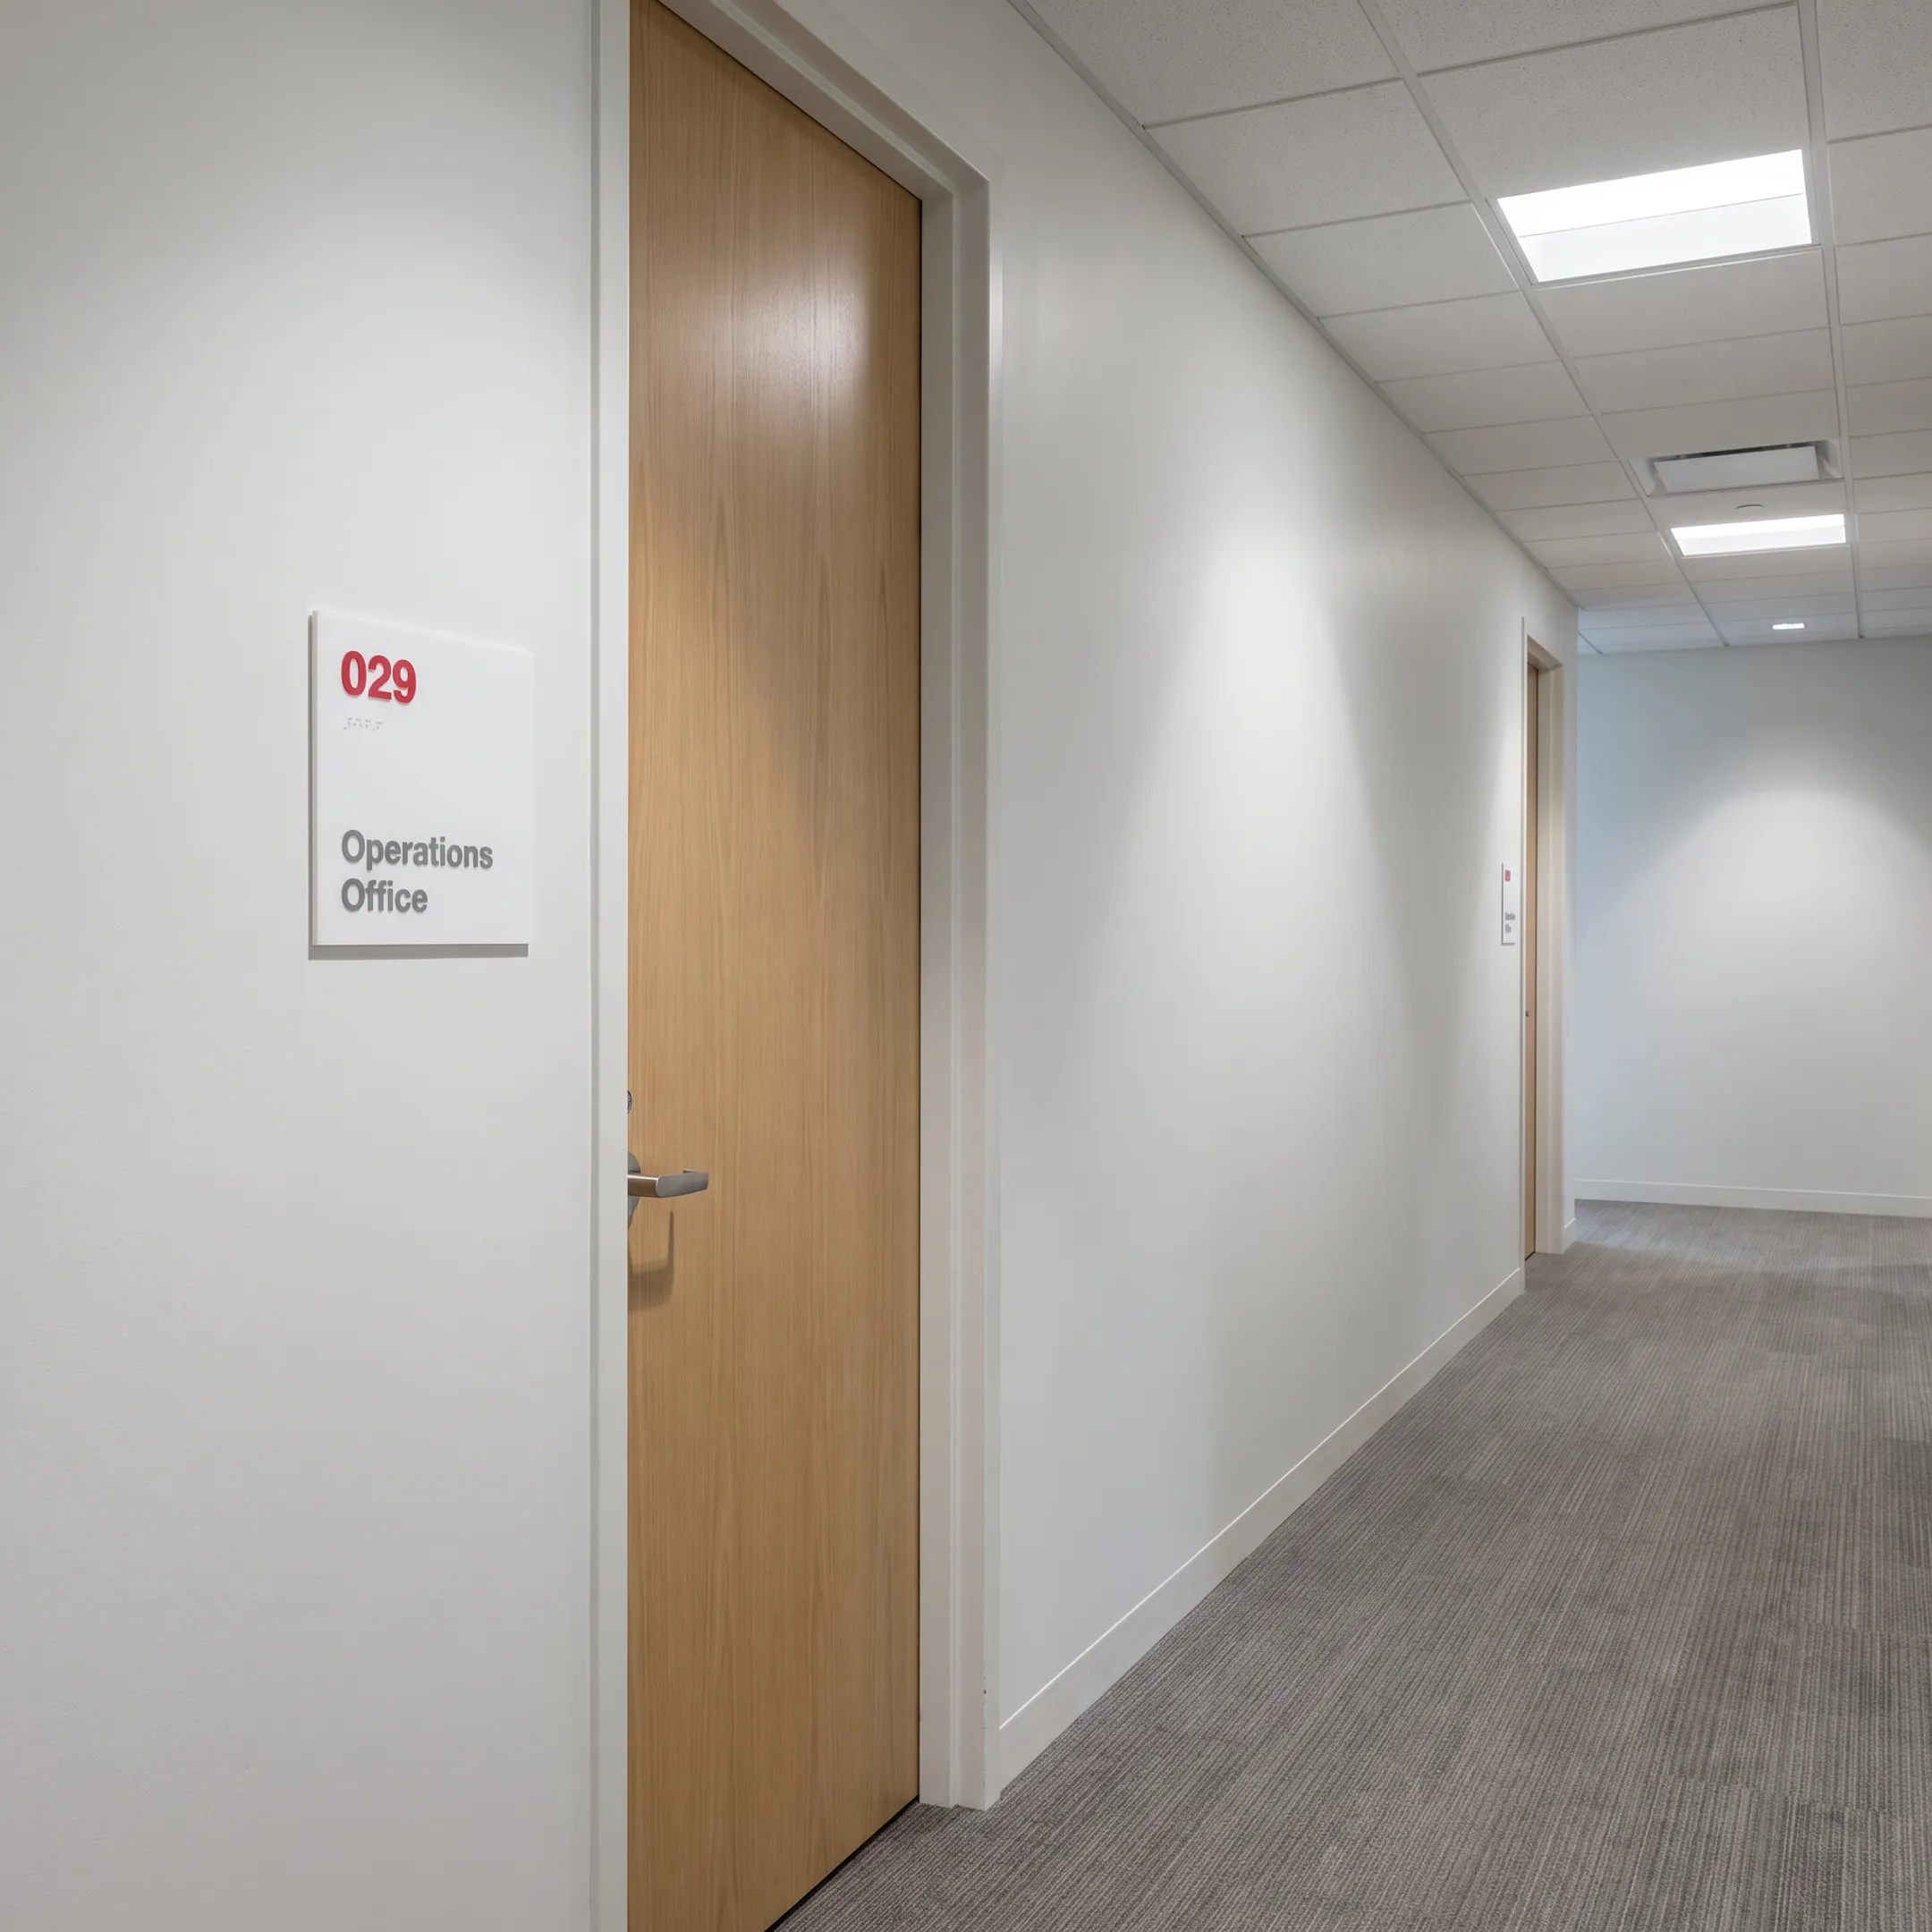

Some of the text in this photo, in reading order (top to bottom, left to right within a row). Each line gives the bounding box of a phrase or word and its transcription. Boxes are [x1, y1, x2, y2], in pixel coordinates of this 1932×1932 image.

[341, 650, 417, 705] 029
[341, 829, 494, 872] Operations
[341, 877, 428, 913] Office
